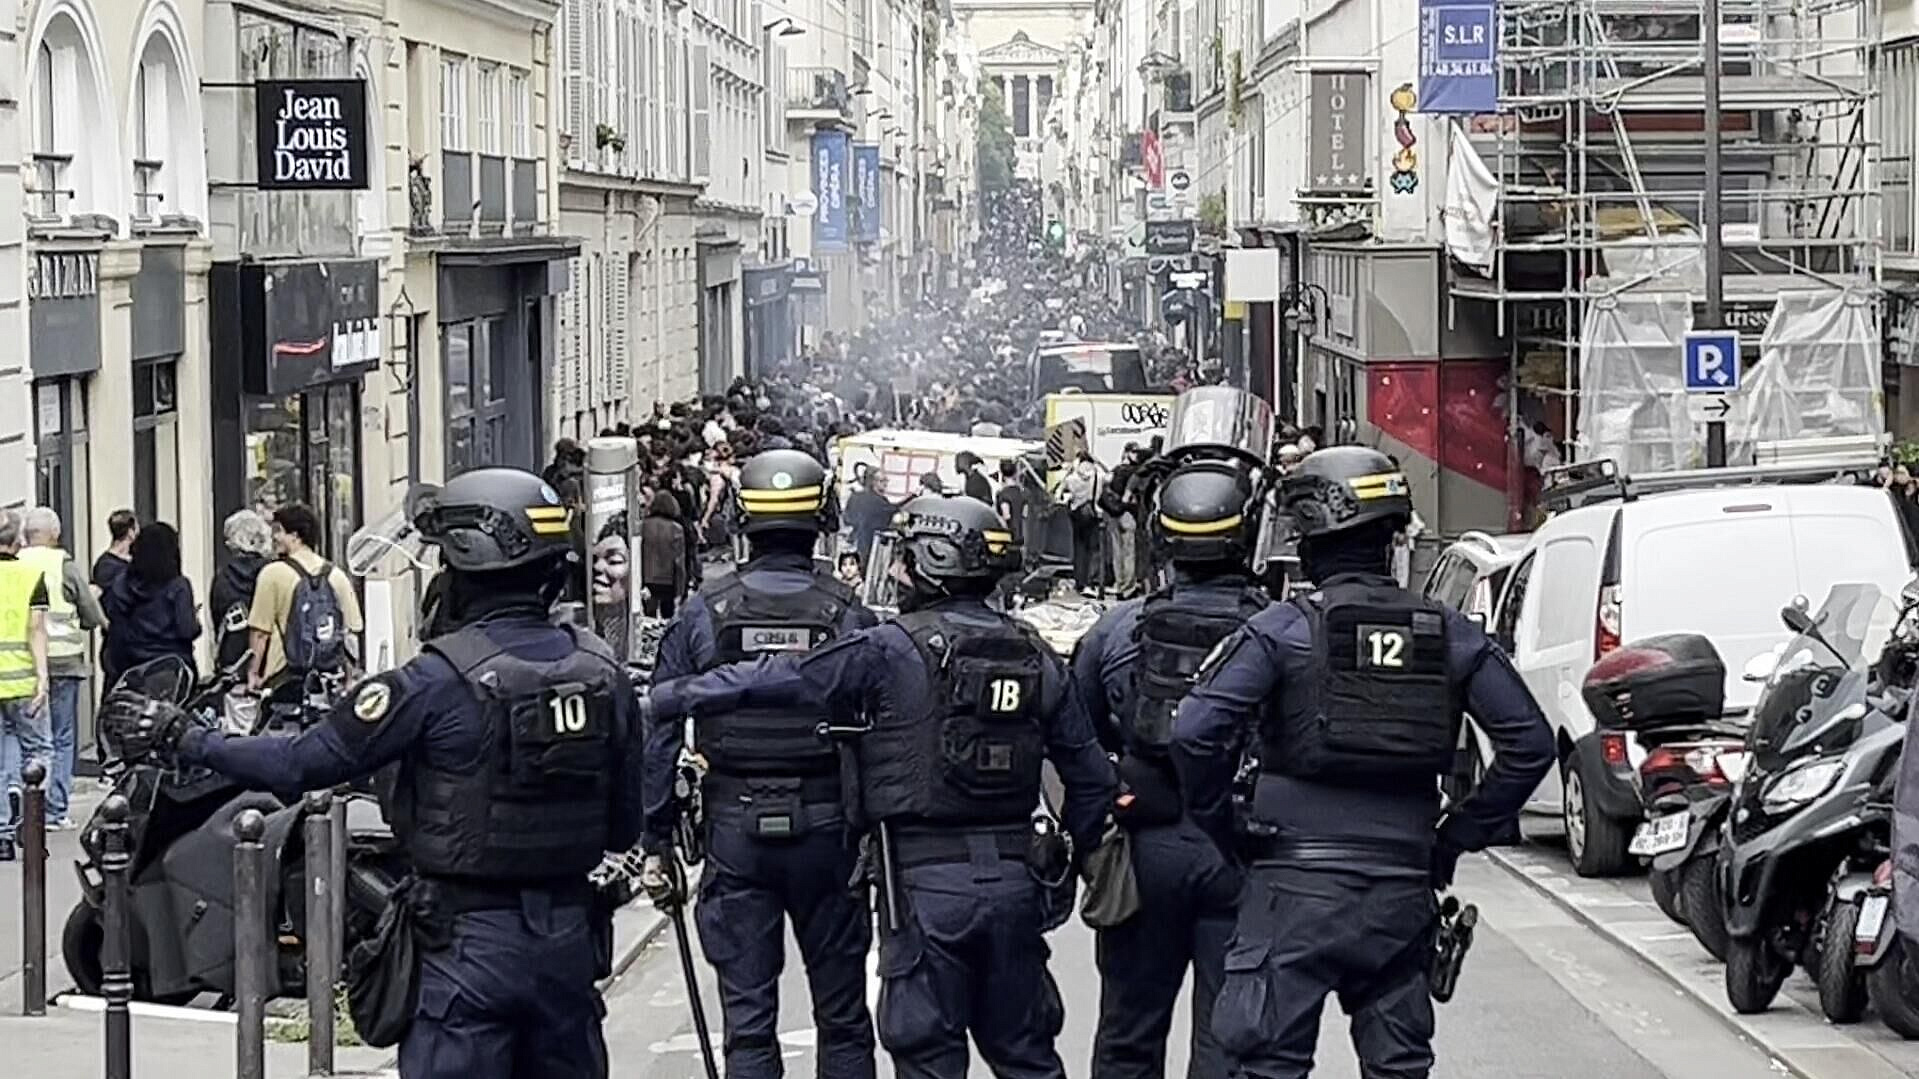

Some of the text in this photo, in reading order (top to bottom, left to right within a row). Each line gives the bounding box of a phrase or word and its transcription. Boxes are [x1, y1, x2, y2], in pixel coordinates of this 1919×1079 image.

[1444, 24, 1484, 45] S.L.R
[279, 89, 342, 120] Jean
[276, 120, 347, 150] Louis
[1331, 74, 1345, 170] HOTEL
[274, 150, 352, 181] David
[1697, 344, 1723, 380] P
[1368, 631, 1403, 666] 12
[549, 694, 587, 733] 10
